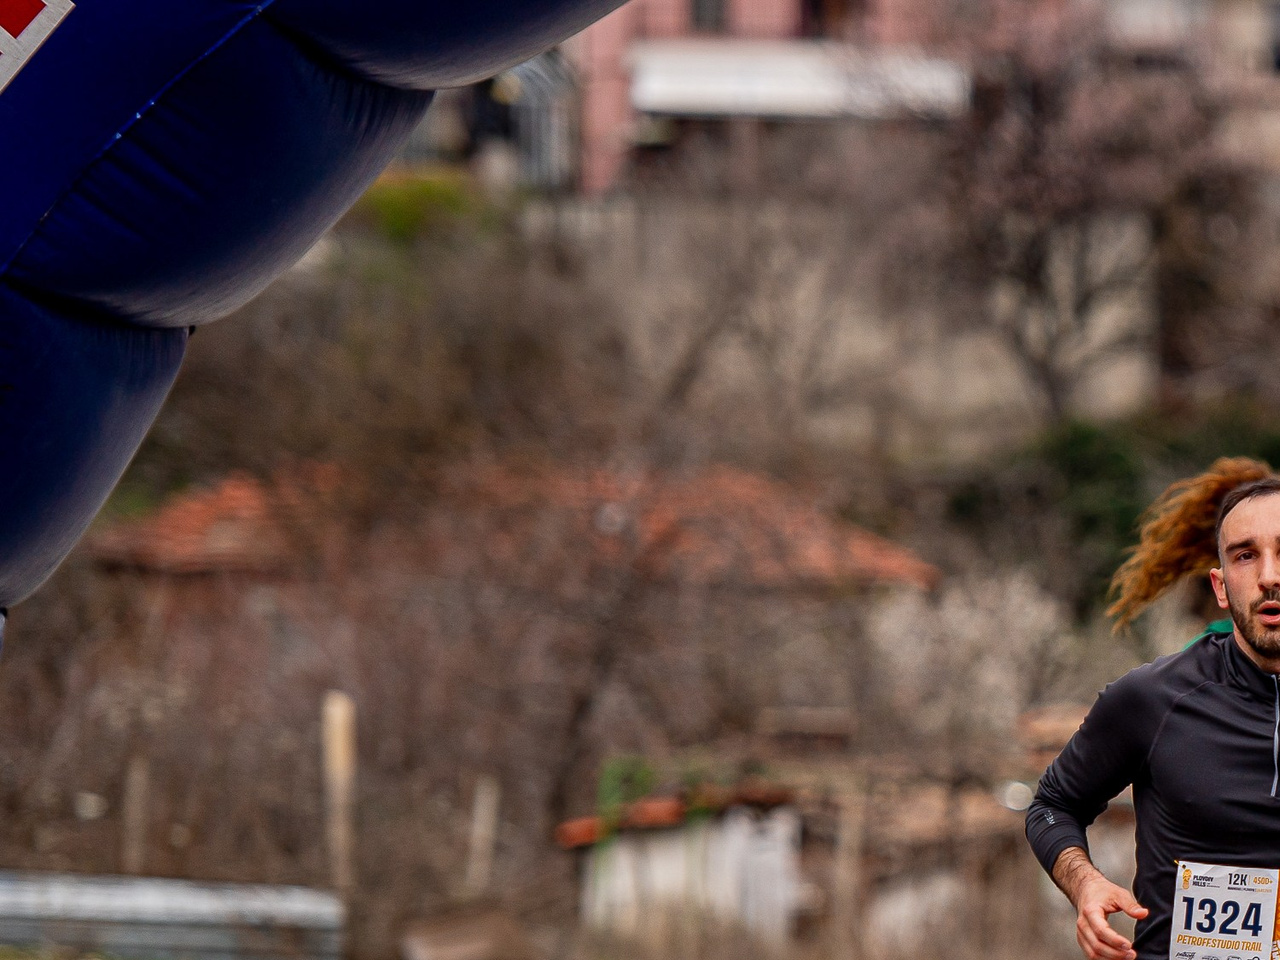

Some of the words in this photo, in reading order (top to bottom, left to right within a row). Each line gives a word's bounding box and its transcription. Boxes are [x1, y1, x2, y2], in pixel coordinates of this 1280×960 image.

[1228, 873, 1248, 886] 12K
[1182, 896, 1262, 937] 1324
[1241, 941, 1262, 952] TRAIL
